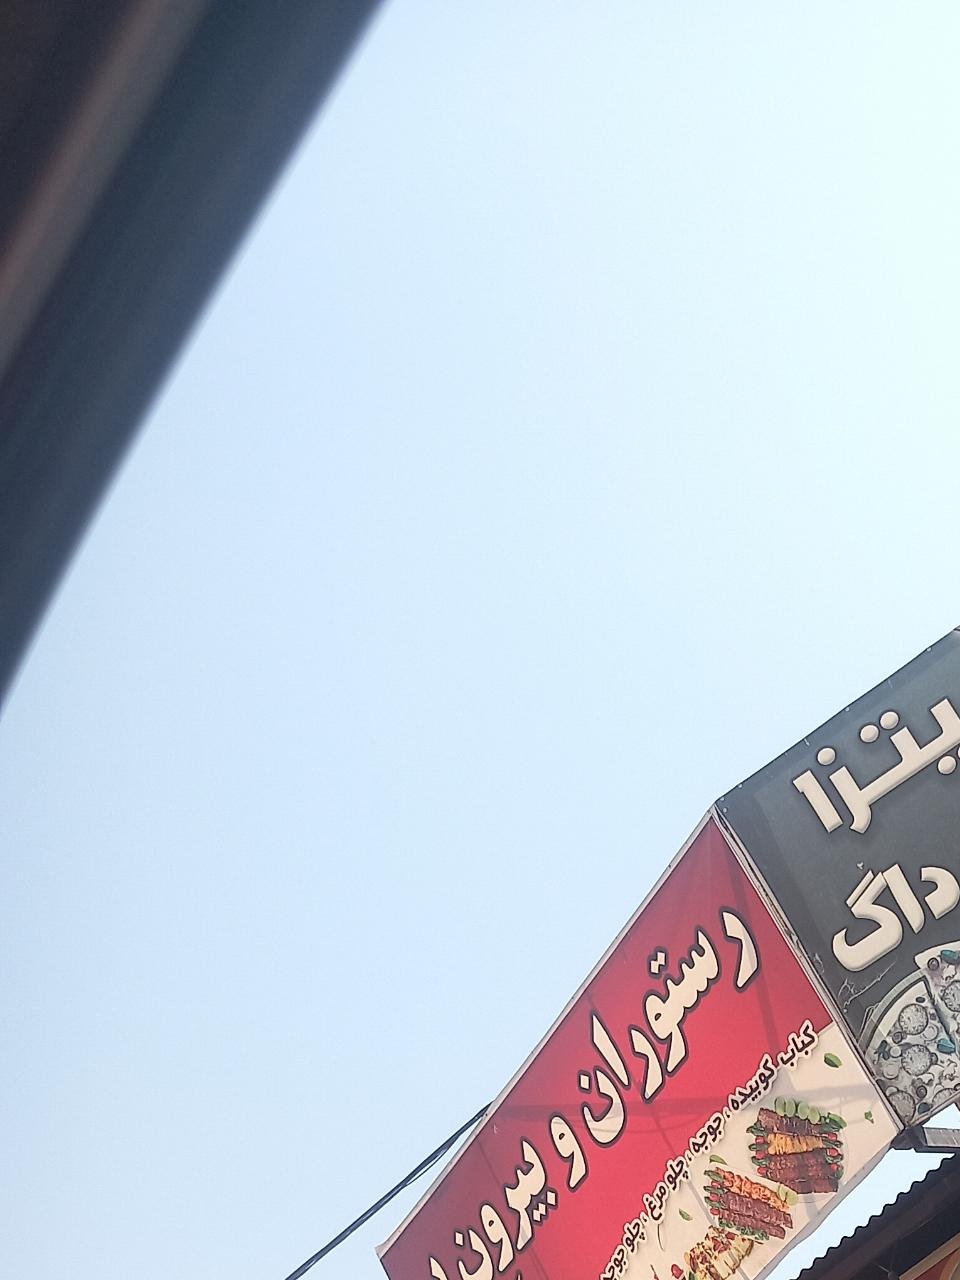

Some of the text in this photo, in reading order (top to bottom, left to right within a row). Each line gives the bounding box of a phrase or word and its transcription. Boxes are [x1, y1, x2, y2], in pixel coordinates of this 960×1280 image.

[576, 909, 761, 1149] رستوران
[779, 1021, 818, 1068] کباب
[549, 1114, 590, 1192] و
[665, 1155, 691, 1190] چلو
[623, 1219, 647, 1253] چلو
